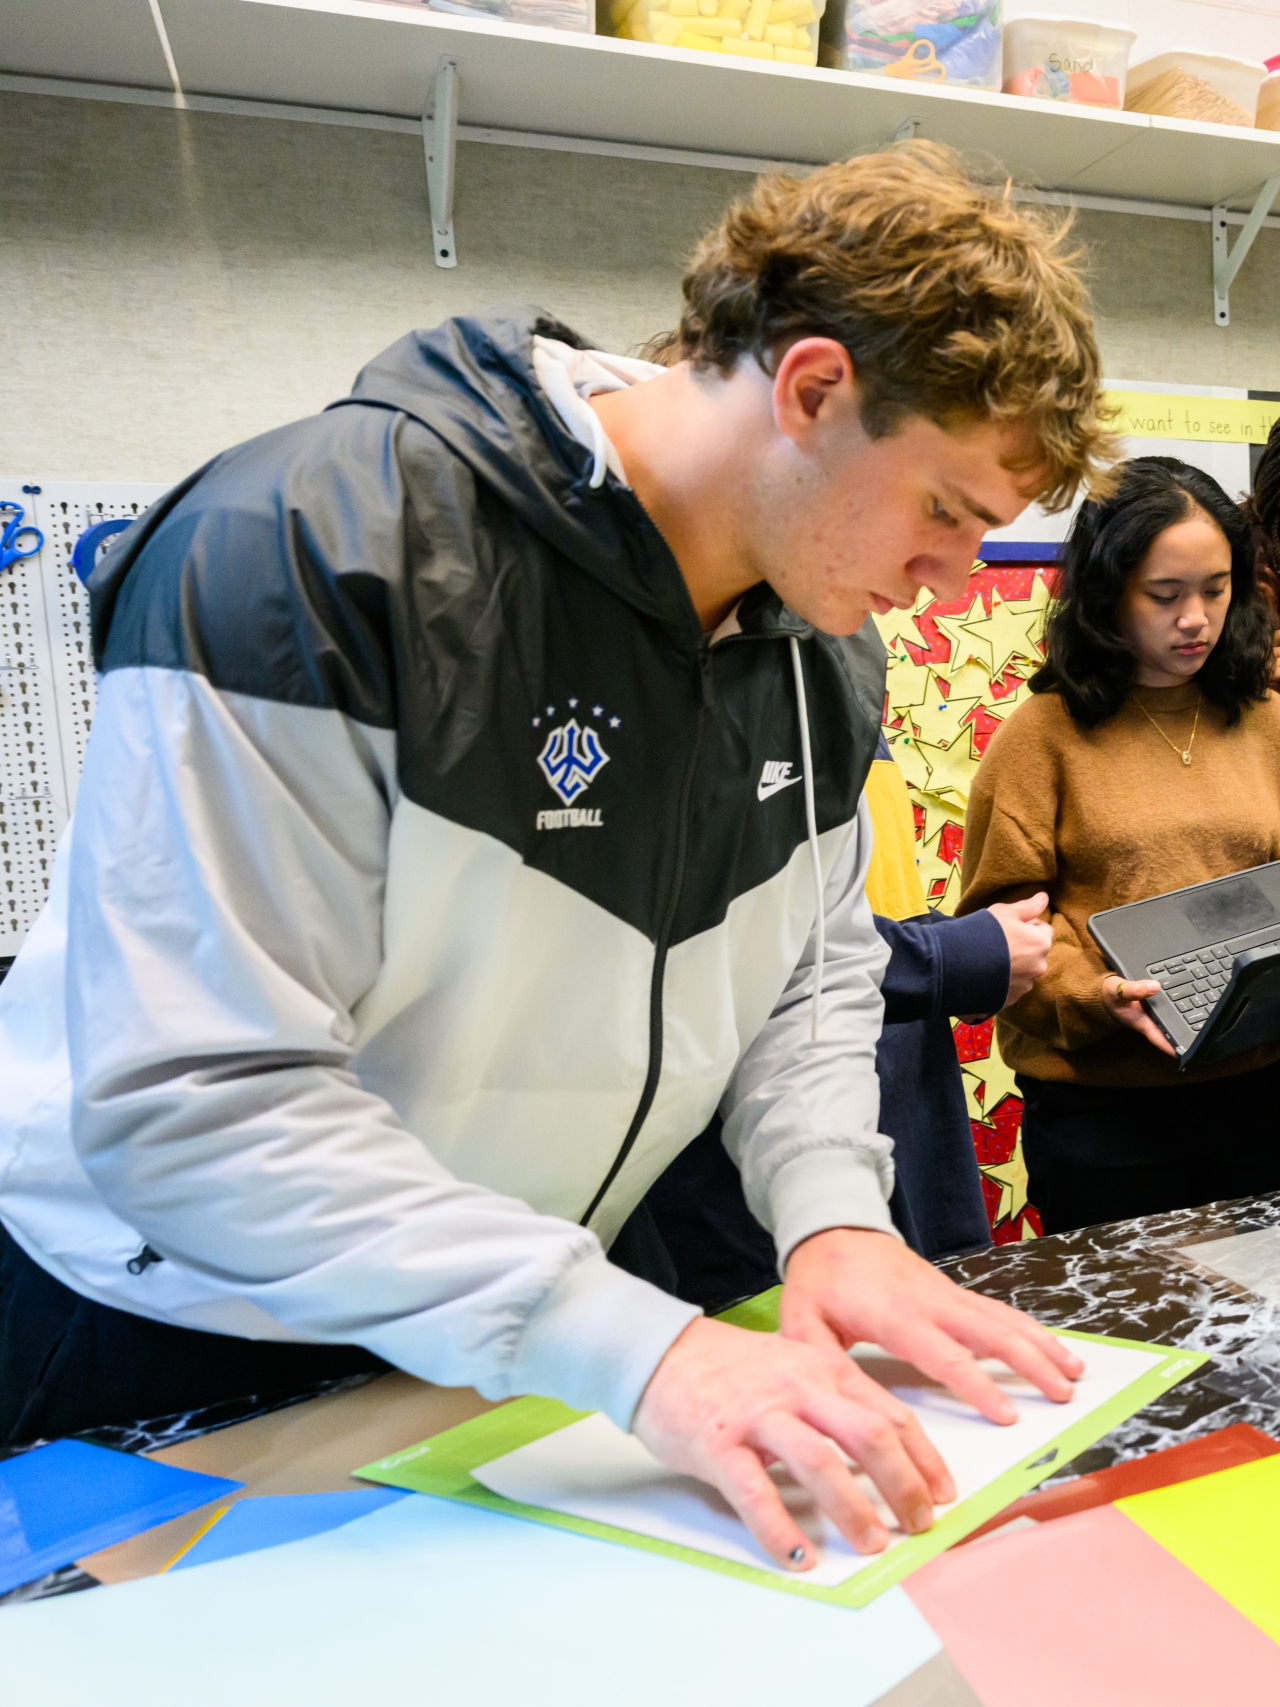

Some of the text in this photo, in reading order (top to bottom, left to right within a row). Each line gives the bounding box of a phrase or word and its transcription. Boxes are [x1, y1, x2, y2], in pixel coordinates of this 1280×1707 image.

[1048, 52, 1094, 74] Sand
[1128, 408, 1174, 432] want
[1183, 409, 1201, 434] to
[1208, 420, 1232, 435] see
[1240, 423, 1253, 437] in
[762, 760, 794, 784] NIKE
[536, 808, 604, 831] FOOTBALL
